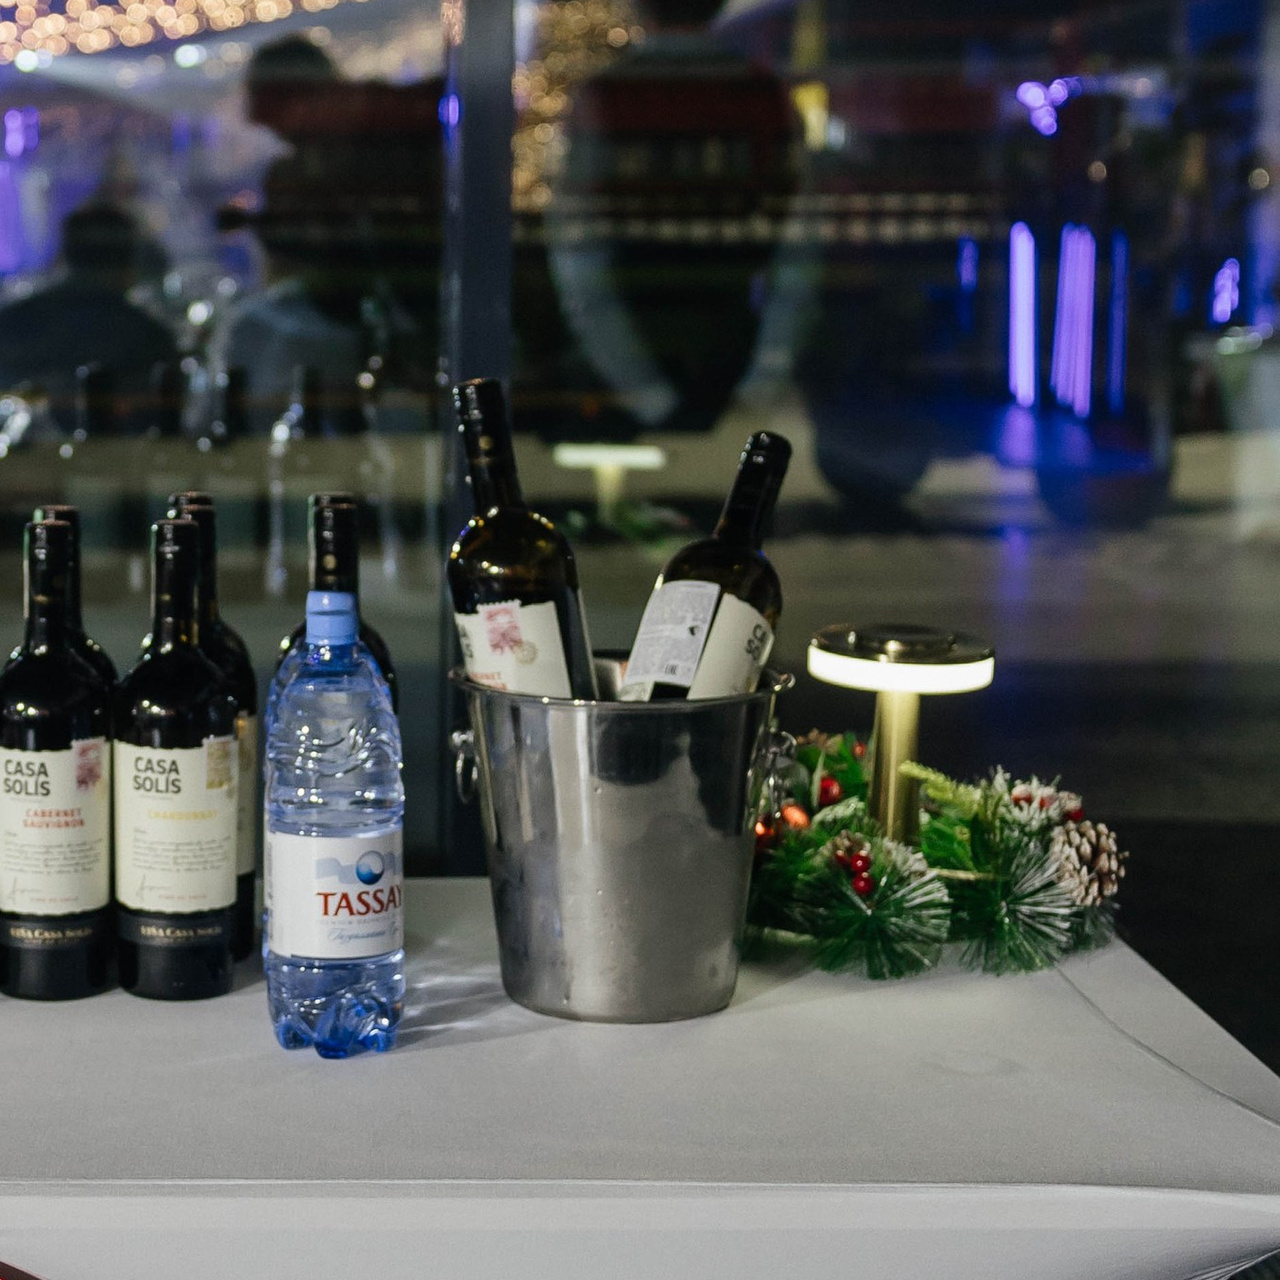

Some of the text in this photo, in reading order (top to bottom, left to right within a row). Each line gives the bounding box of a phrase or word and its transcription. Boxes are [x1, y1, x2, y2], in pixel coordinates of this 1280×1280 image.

[4, 759, 49, 777] CASA
[134, 756, 180, 776] CASA
[26, 807, 82, 818] CABERNET
[23, 818, 86, 828] SAUVIGNON
